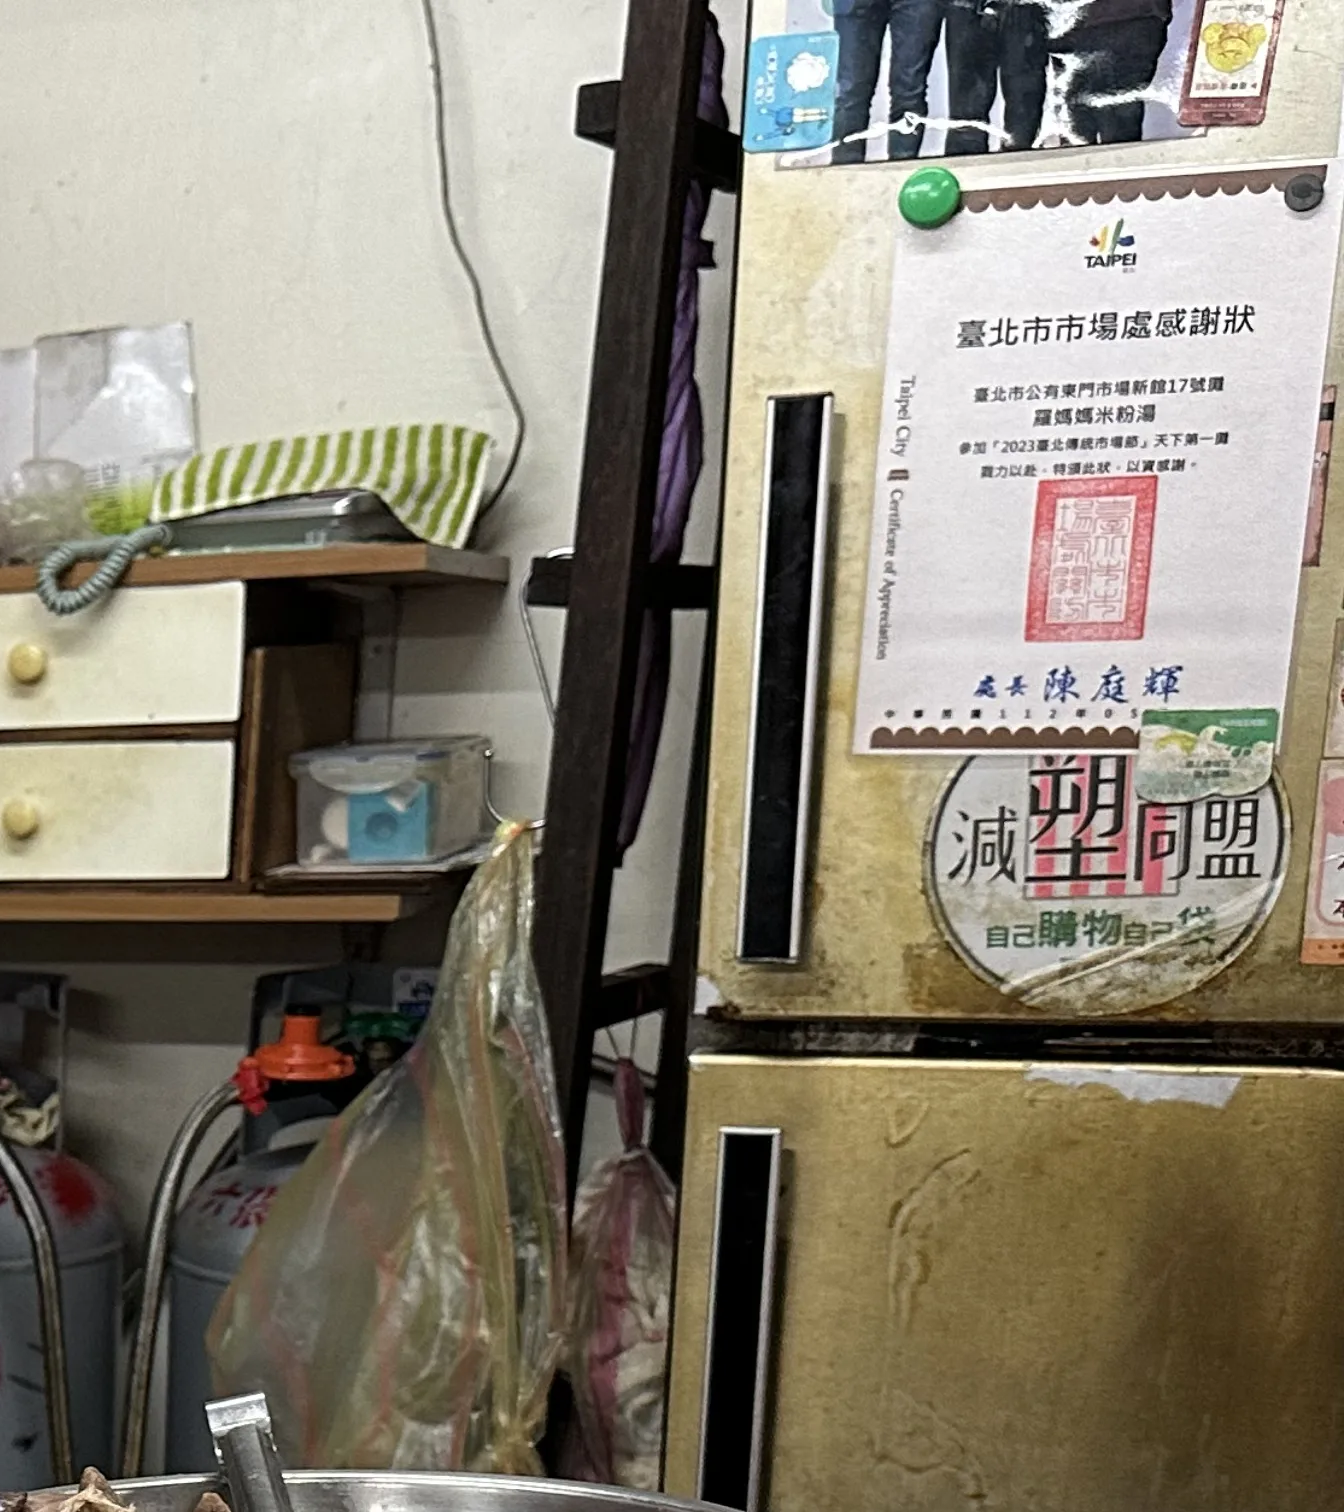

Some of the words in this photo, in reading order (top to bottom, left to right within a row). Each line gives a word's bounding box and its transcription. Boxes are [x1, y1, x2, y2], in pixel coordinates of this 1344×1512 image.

[1084, 252, 1137, 269] TAIPEI
[956, 304, 1256, 349] 臺北市市場處感謝狀
[894, 375, 916, 421] Taipei
[1033, 404, 1156, 427] 羅媽媽米粉湯
[890, 425, 912, 457] City
[884, 488, 904, 557] Certificate
[884, 560, 897, 576] of
[876, 577, 896, 660] Appreciation
[1043, 665, 1184, 703] 陳庭輝
[947, 754, 1262, 887] 減塑同盟
